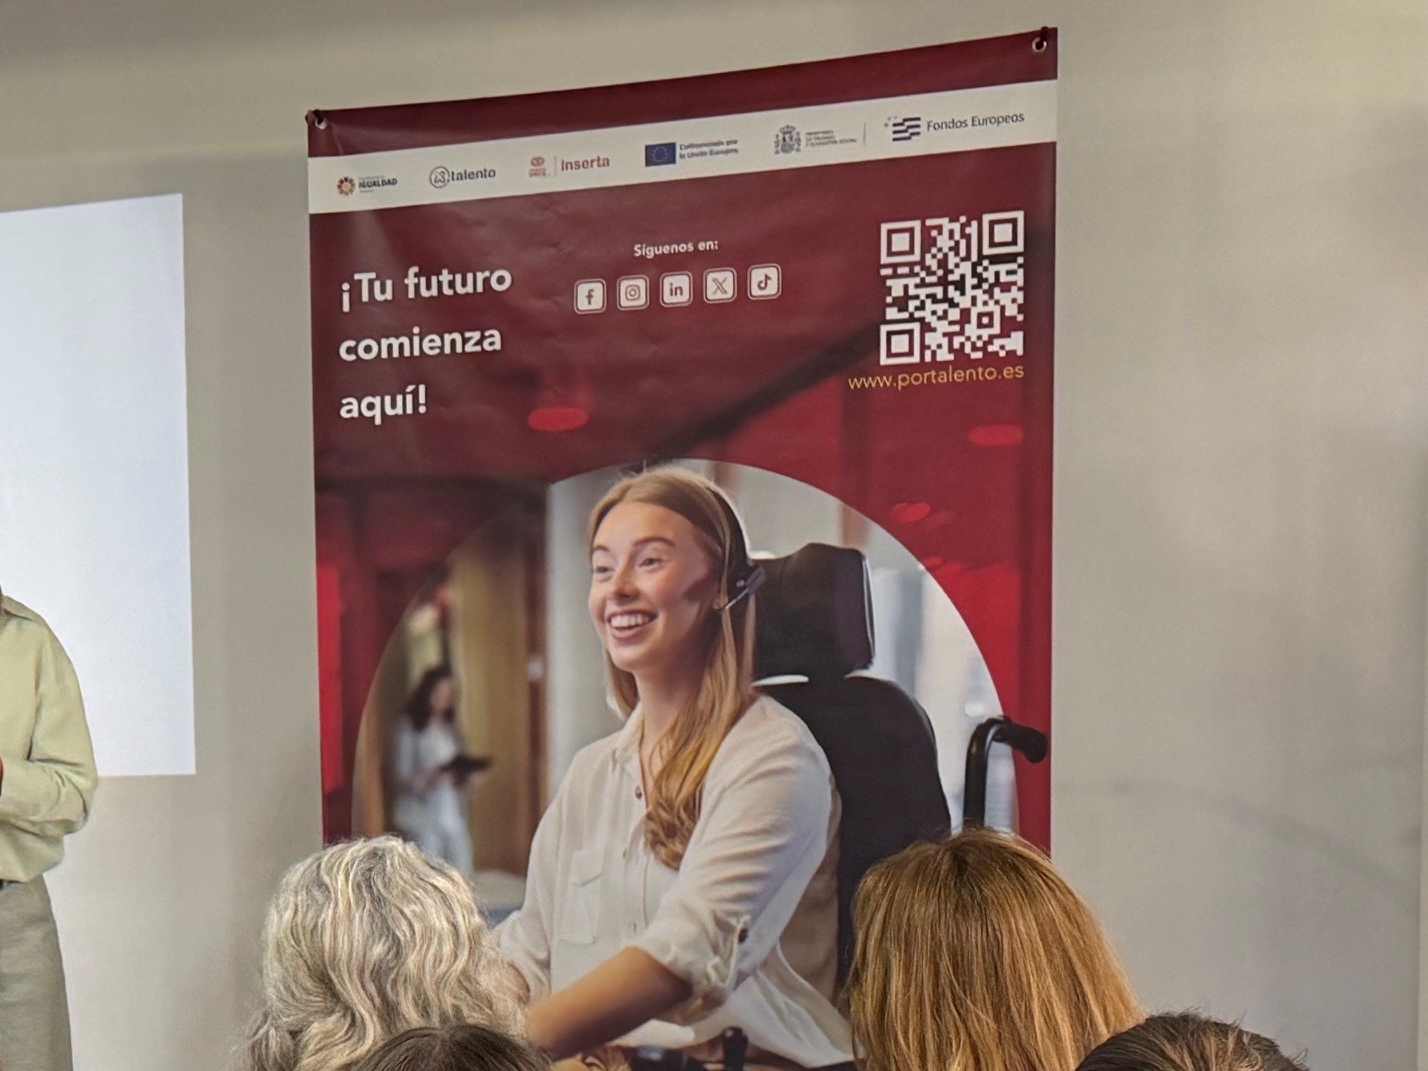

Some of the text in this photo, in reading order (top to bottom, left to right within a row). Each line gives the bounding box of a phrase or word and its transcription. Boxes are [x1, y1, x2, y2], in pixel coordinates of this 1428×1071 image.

[927, 113, 1025, 131] Fondos Europeos
[561, 155, 610, 171] Inserta
[633, 240, 719, 259] Síguenos en:
[341, 265, 512, 313] ¡Tu futuro
[338, 325, 502, 362] comienza
[848, 365, 1024, 391] www.portalento.es
[339, 383, 427, 426] aquí!
